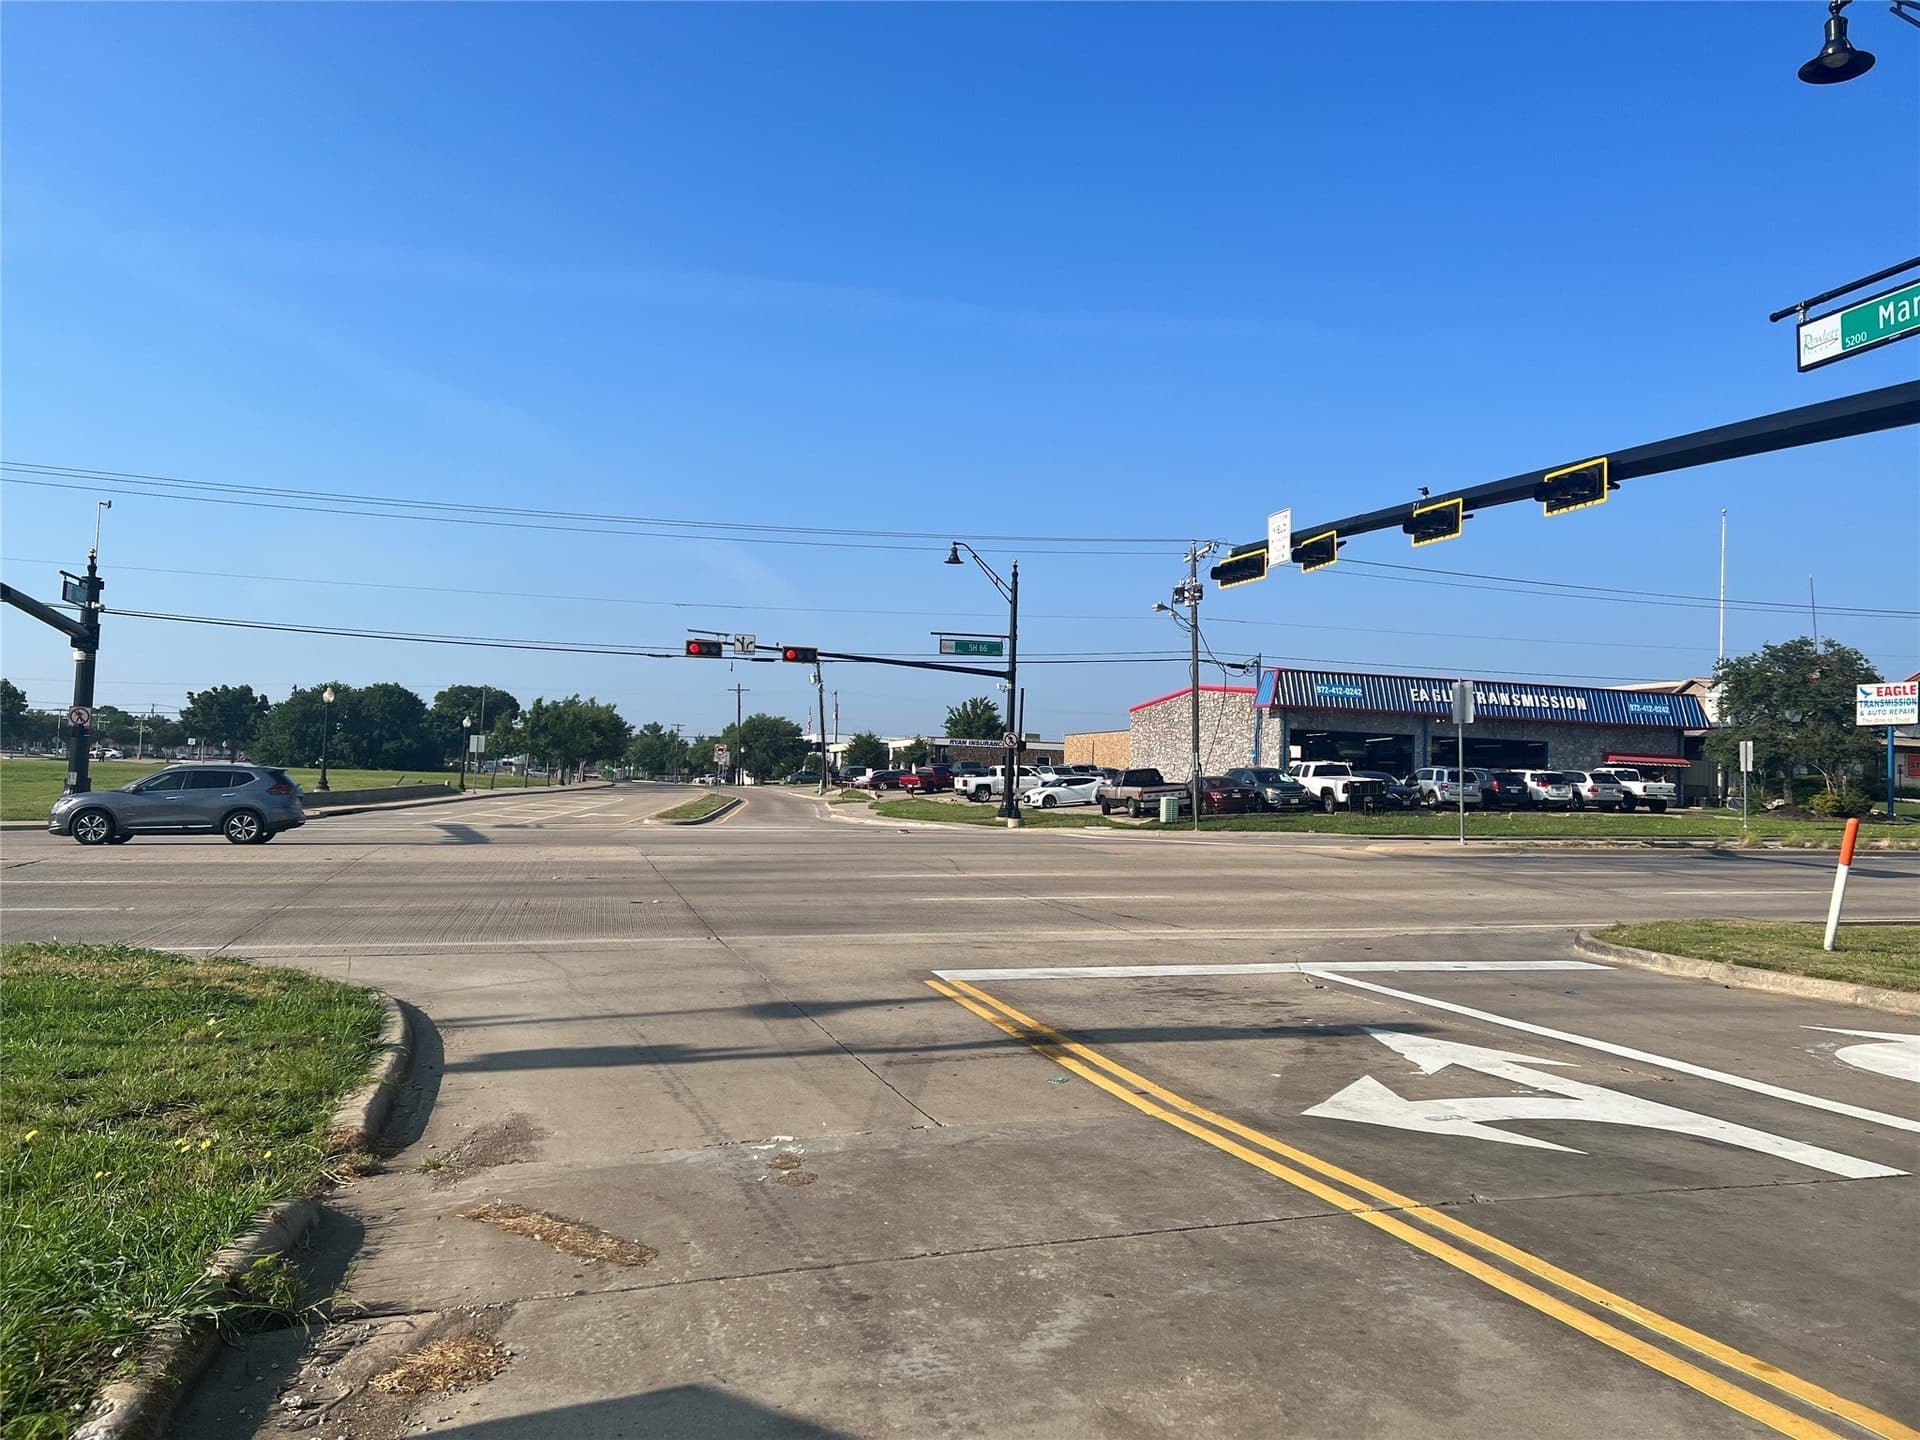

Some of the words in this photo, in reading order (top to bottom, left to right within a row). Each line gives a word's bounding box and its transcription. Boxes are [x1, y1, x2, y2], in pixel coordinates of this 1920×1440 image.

[1845, 331, 1867, 347] 5200
[969, 643, 977, 651] SH
[979, 644, 988, 652] 66
[1317, 686, 1362, 696] 972-412-0242
[1876, 685, 1916, 697] EAGLE
[1860, 697, 1917, 709] TRANSMISSION
[1889, 707, 1915, 716] REPAIR
